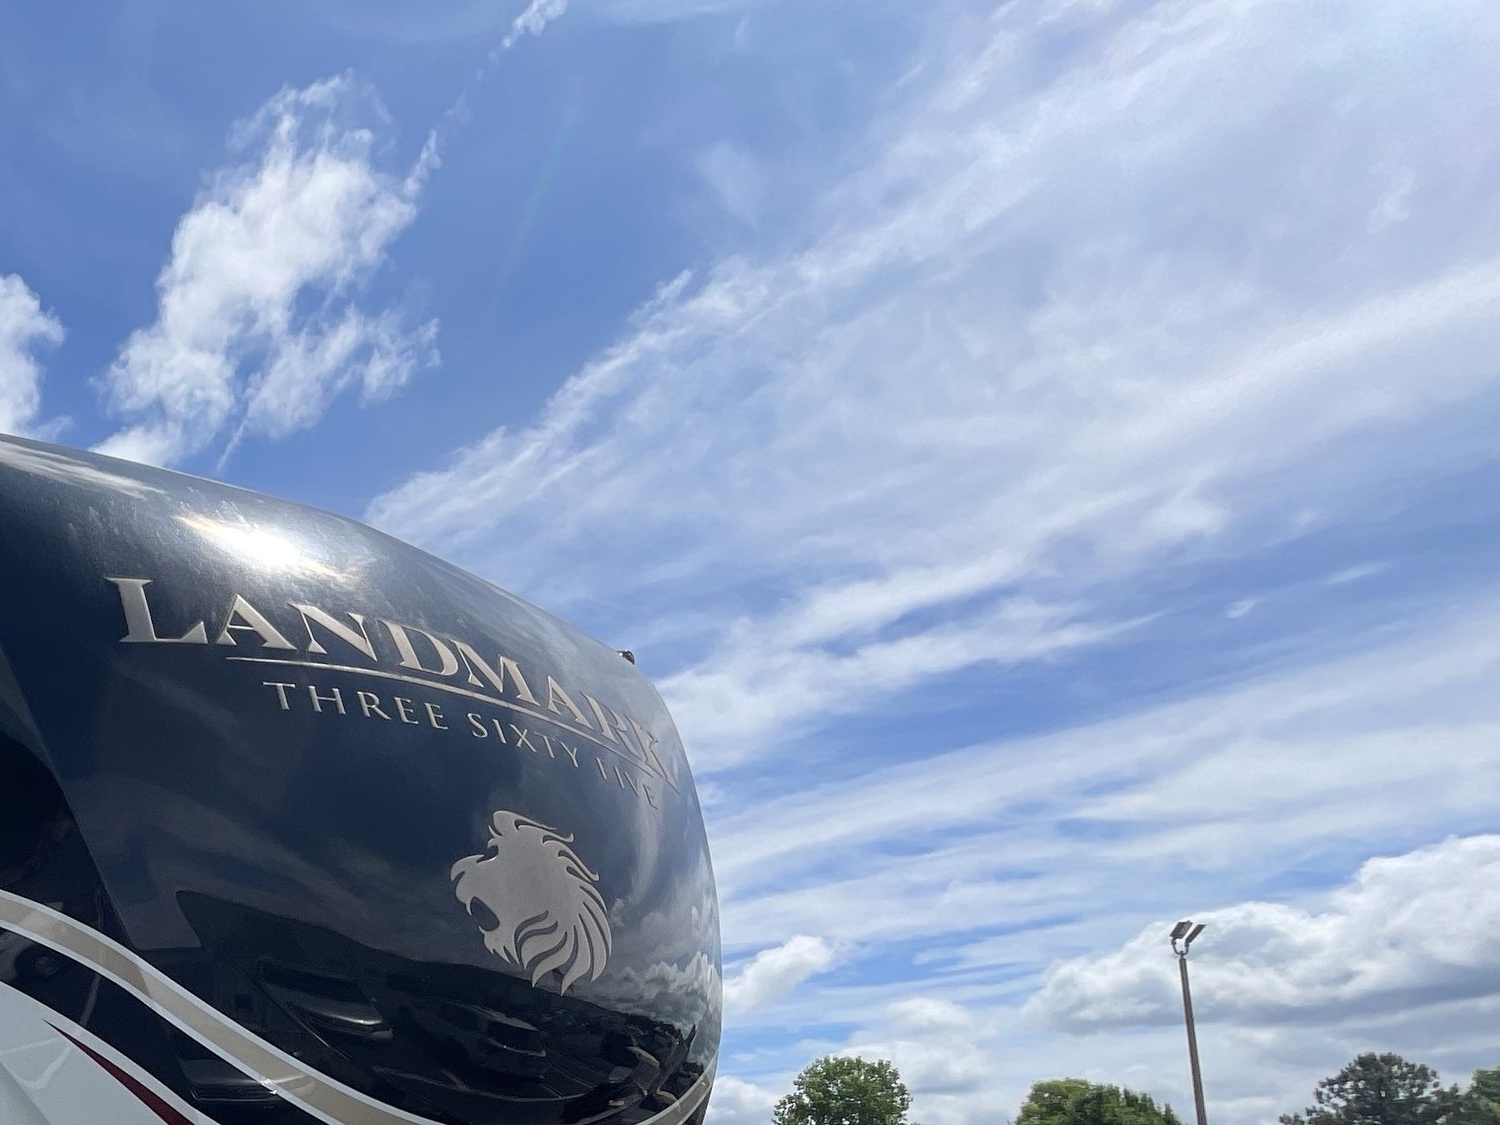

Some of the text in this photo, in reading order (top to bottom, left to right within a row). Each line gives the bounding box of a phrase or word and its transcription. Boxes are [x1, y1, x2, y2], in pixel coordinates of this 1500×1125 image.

[105, 576, 681, 796] LANDMARK
[262, 681, 658, 810] THREE SIXTY FIVE
